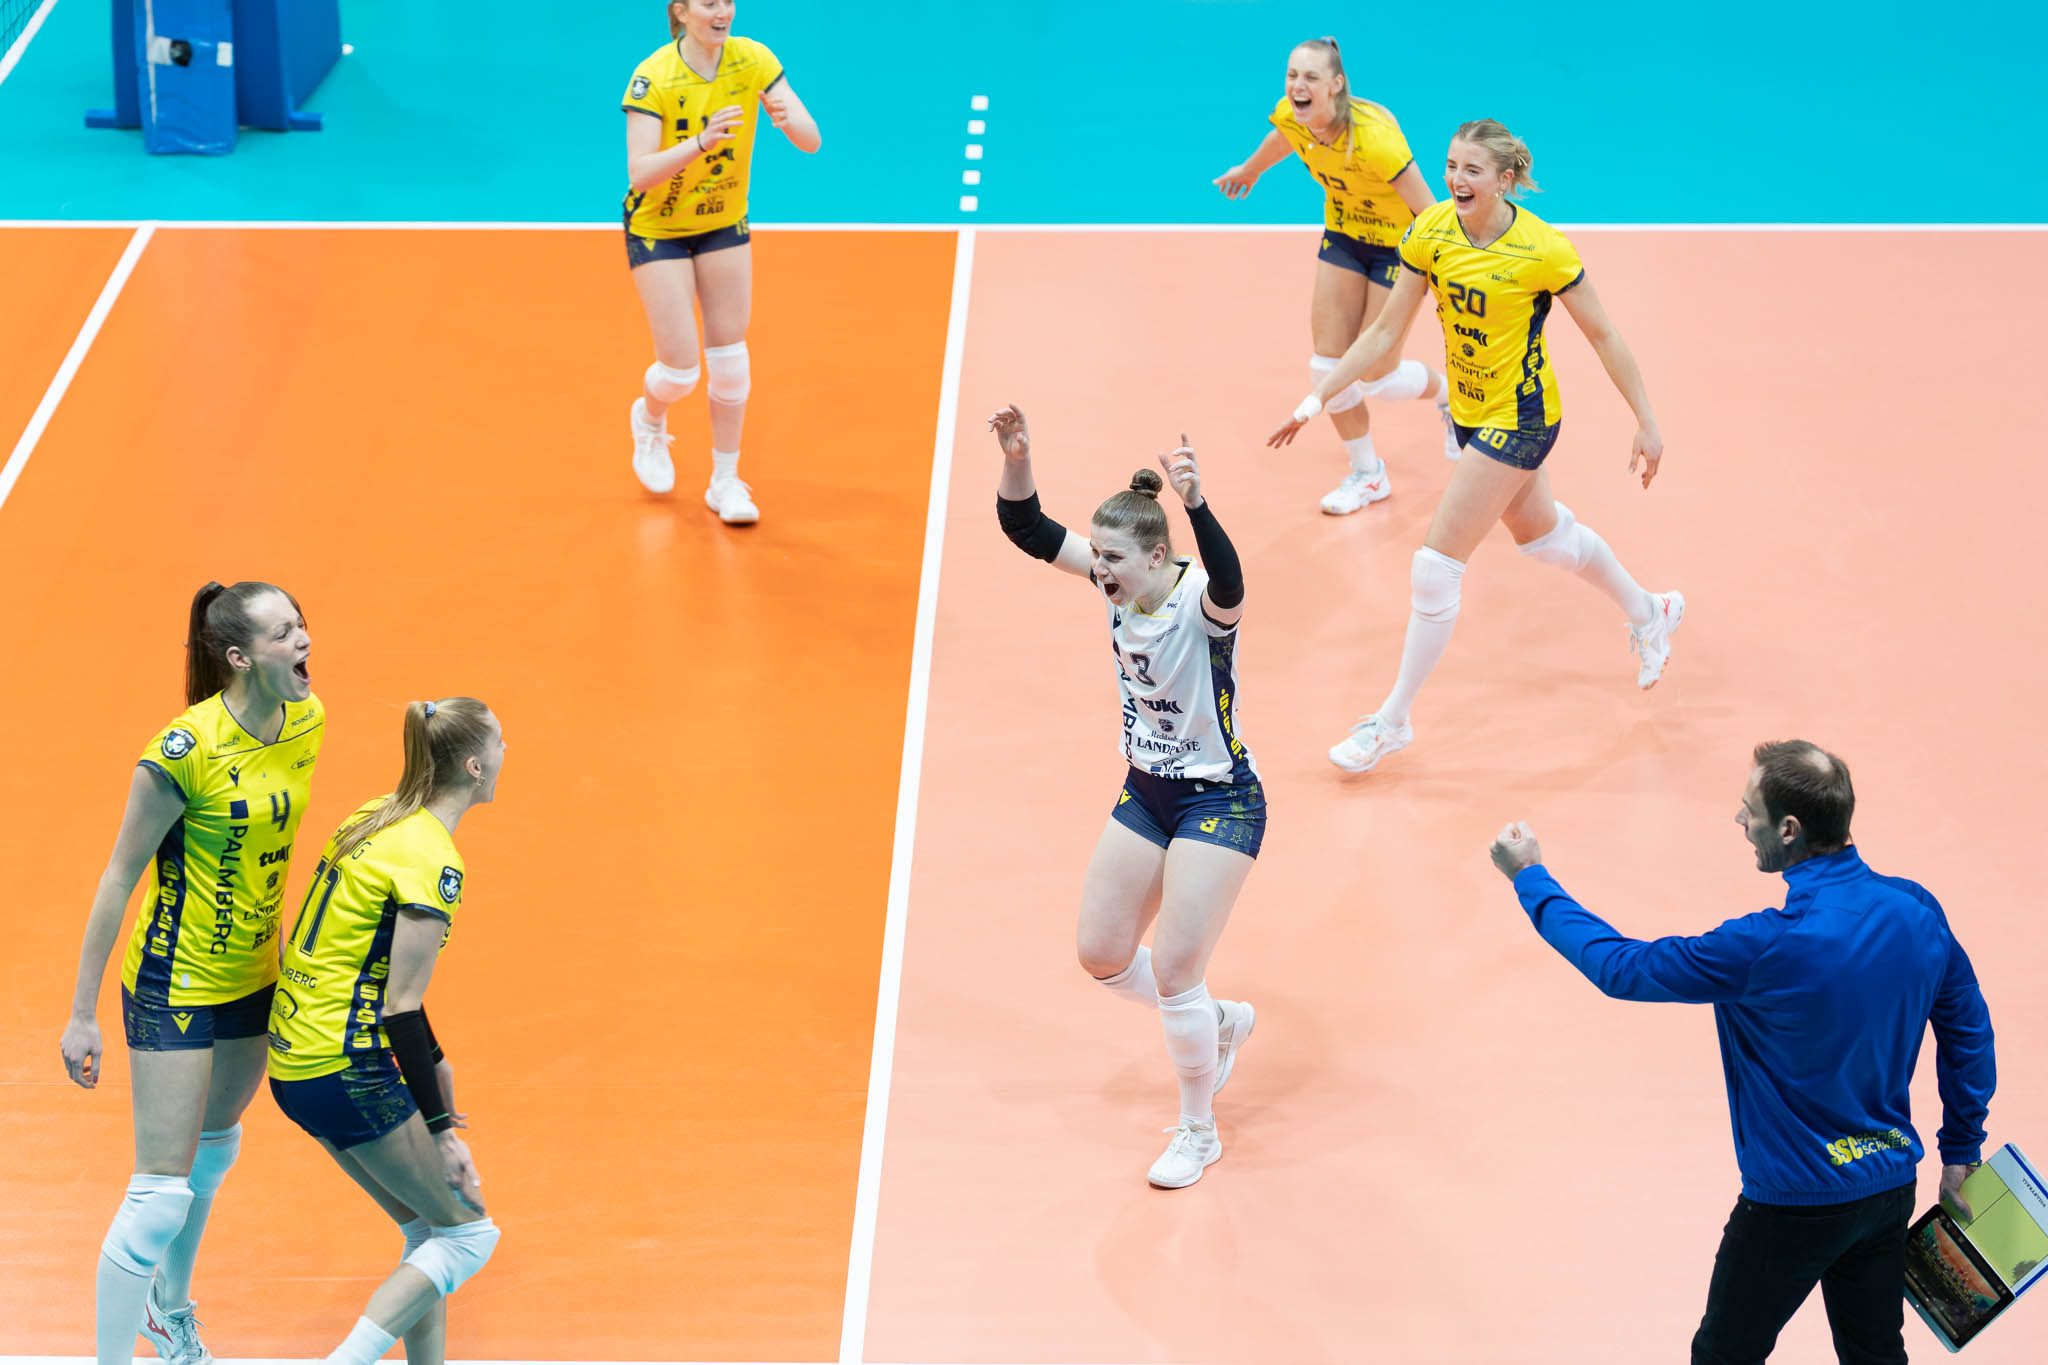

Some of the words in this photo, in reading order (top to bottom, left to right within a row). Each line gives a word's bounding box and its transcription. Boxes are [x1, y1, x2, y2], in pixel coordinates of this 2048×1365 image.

[1447, 280, 1486, 318] 20
[269, 788, 292, 833] 4
[209, 825, 249, 956] PALMBERG
[1826, 1135, 1864, 1167] SSC
